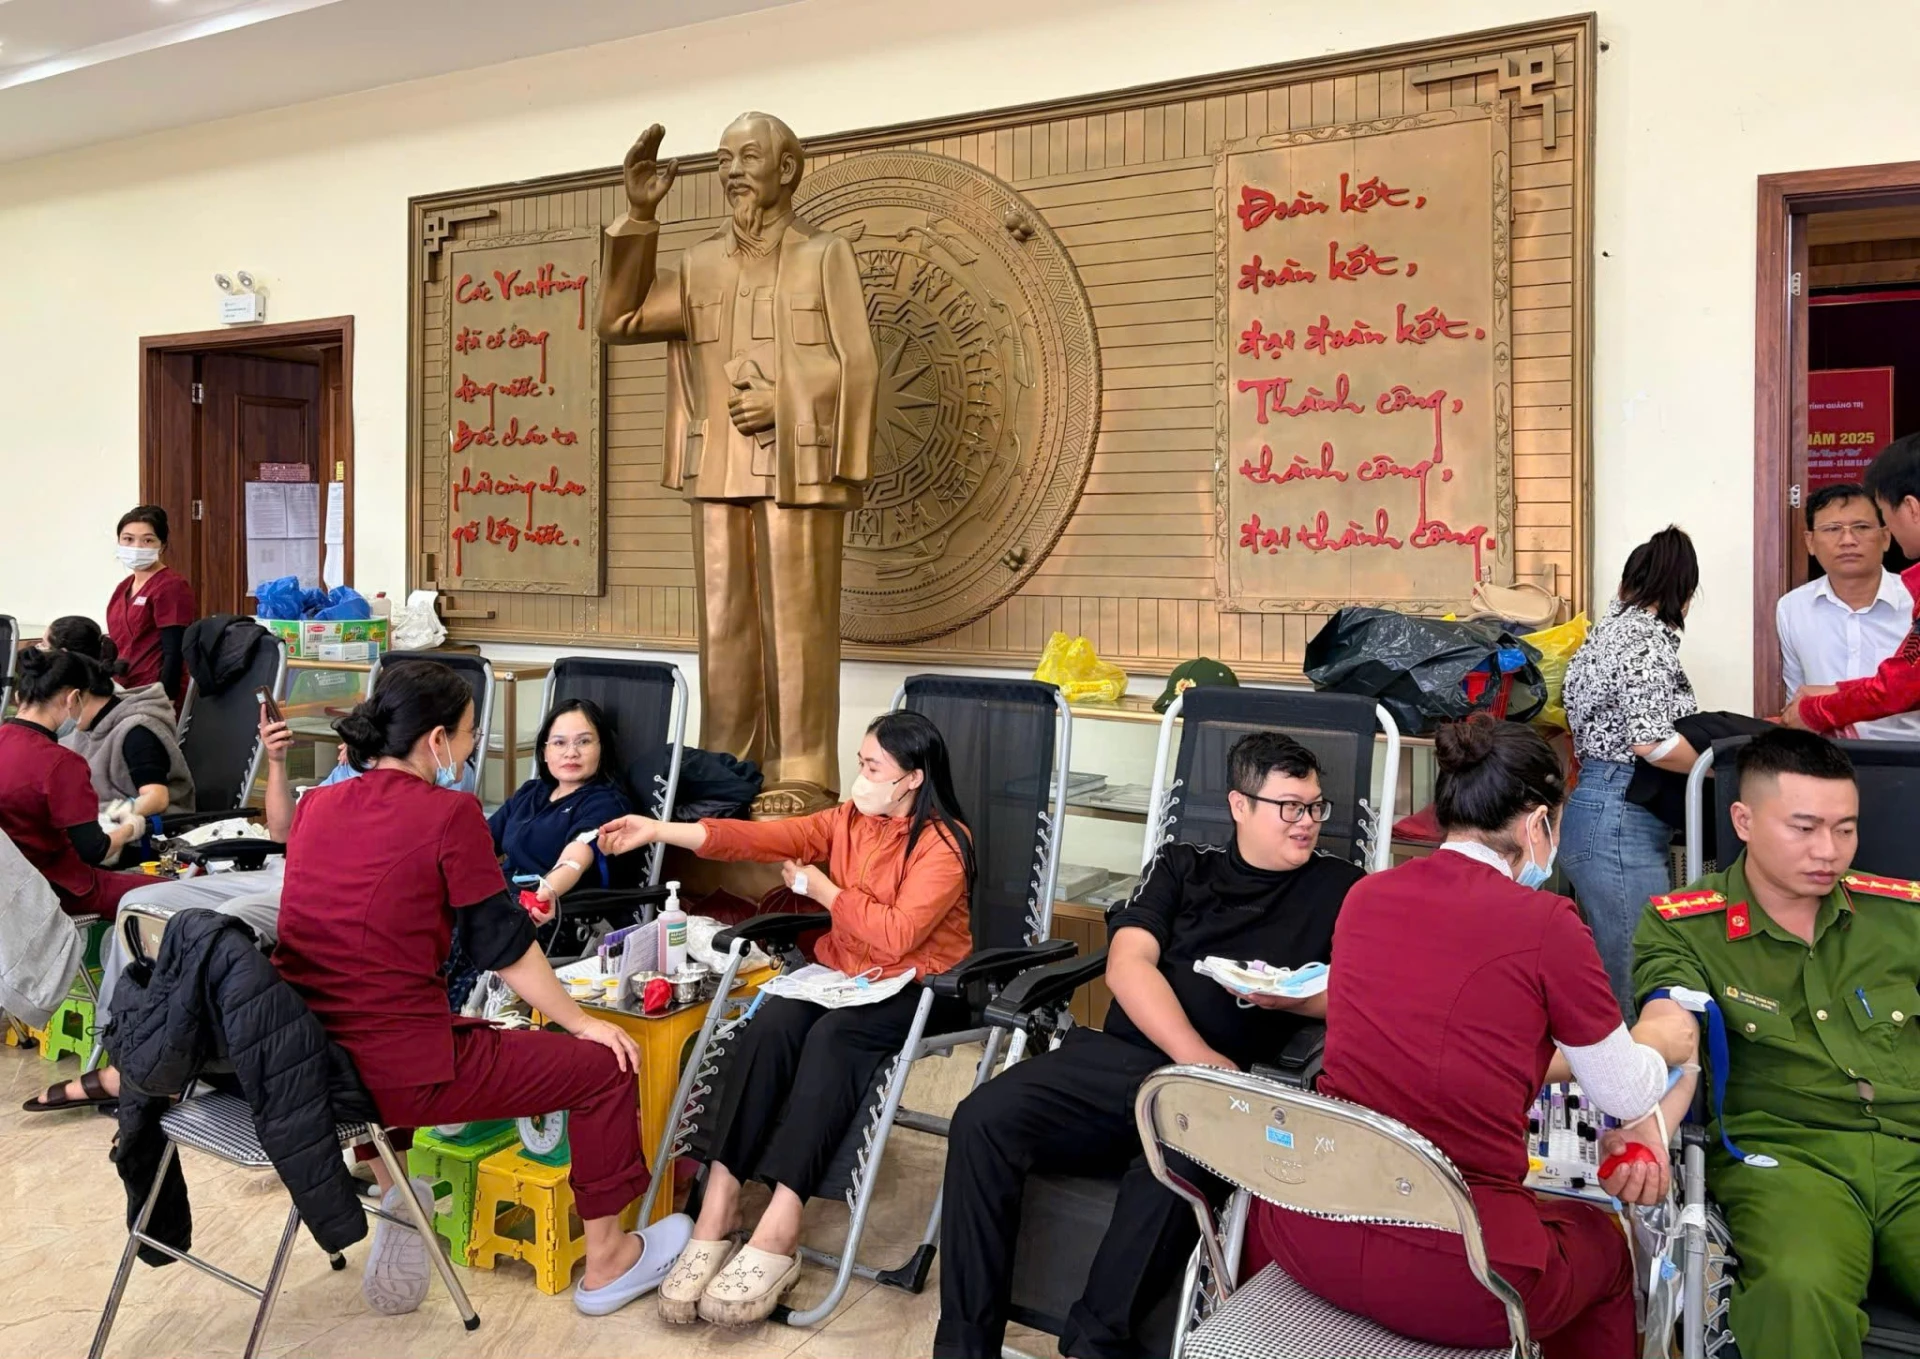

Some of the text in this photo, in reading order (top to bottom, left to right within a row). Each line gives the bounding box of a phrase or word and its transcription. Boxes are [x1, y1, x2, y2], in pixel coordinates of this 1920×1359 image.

[1238, 173, 1427, 231] Đoàn kết,
[1238, 241, 1418, 295] đoàn kết,
[456, 263, 588, 331] Các Vua Hùng
[455, 326, 550, 384] đã có công
[1238, 303, 1486, 360] đại đoàn kết.
[1238, 373, 1365, 425] Thành
[452, 417, 578, 453] Bác cháu ta
[1840, 432, 1874, 444] 2025
[1239, 441, 1349, 483] thành
[1239, 513, 1291, 555] đại
[1296, 508, 1403, 550] thành
